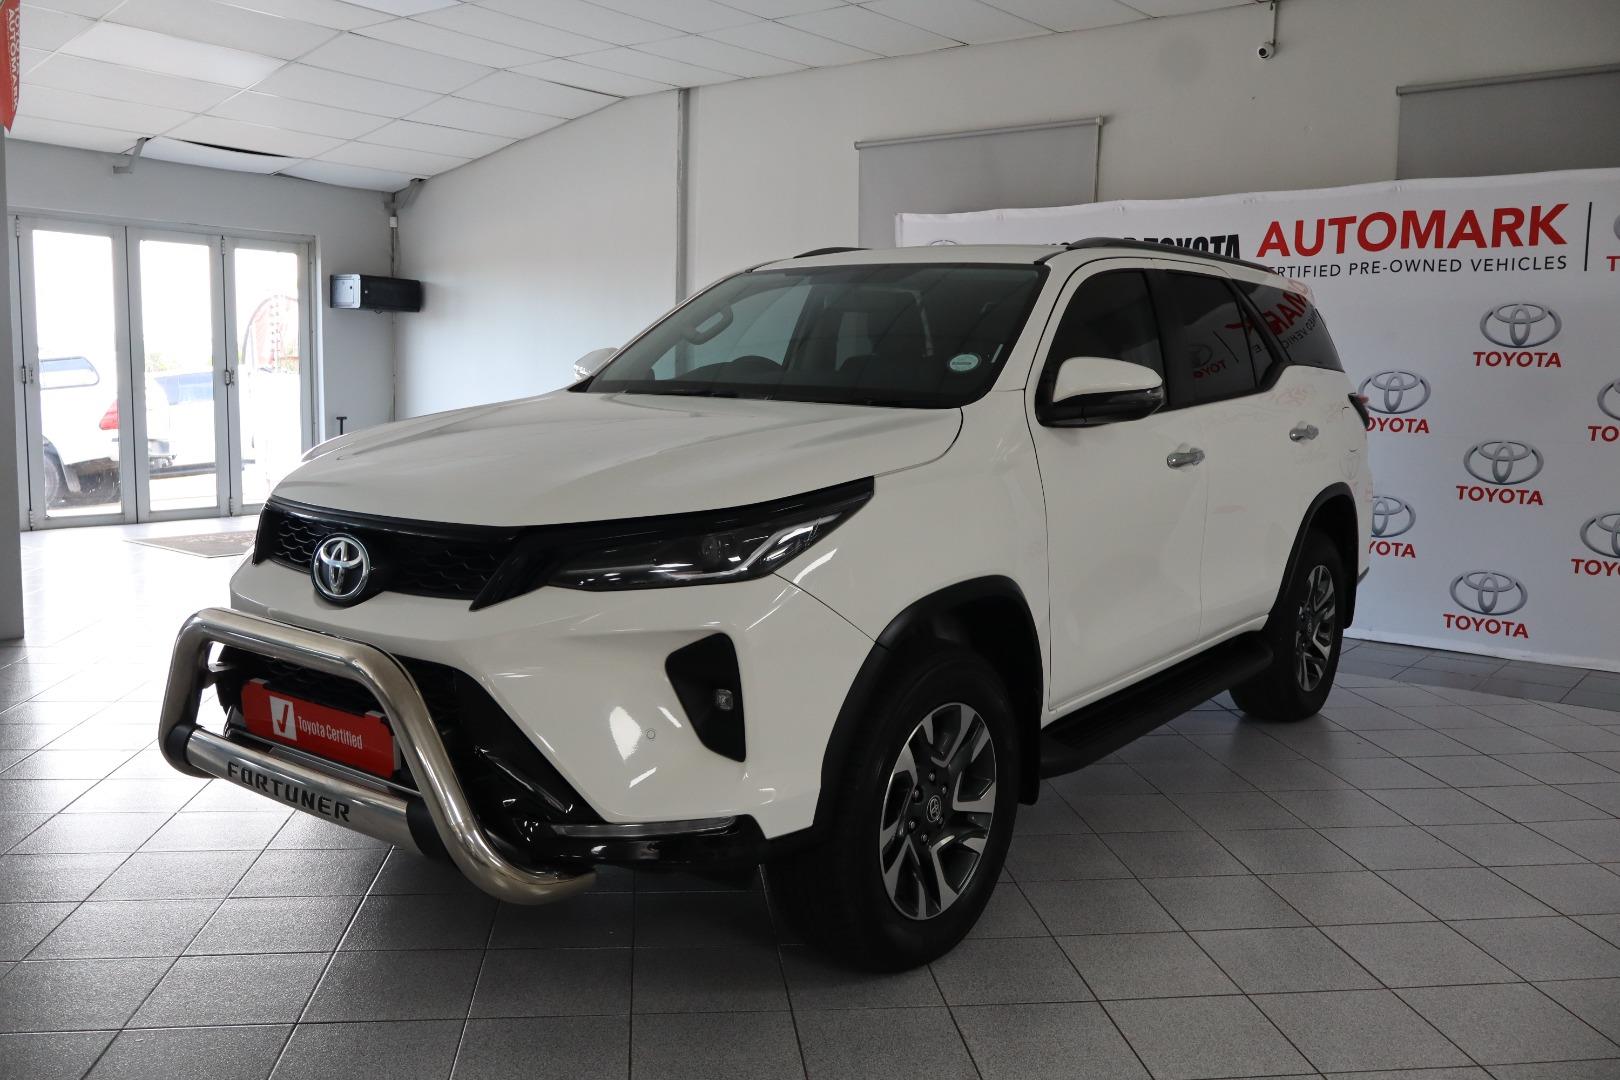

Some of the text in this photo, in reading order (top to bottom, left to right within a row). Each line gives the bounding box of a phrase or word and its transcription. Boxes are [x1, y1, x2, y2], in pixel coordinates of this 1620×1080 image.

[1255, 203, 1570, 258] AUTOMARK
[1267, 255, 1568, 279] RTIFIED PRE-OWNED VEHICLES
[1473, 351, 1562, 368] TOYOTA
[1366, 416, 1430, 434] OYOTA
[1456, 485, 1544, 506] TOYOTA
[1571, 558, 1620, 577] TOY
[1443, 613, 1529, 639] TOYOTA
[297, 716, 363, 750] Toyota Certified
[227, 761, 350, 823] FORTUNER
